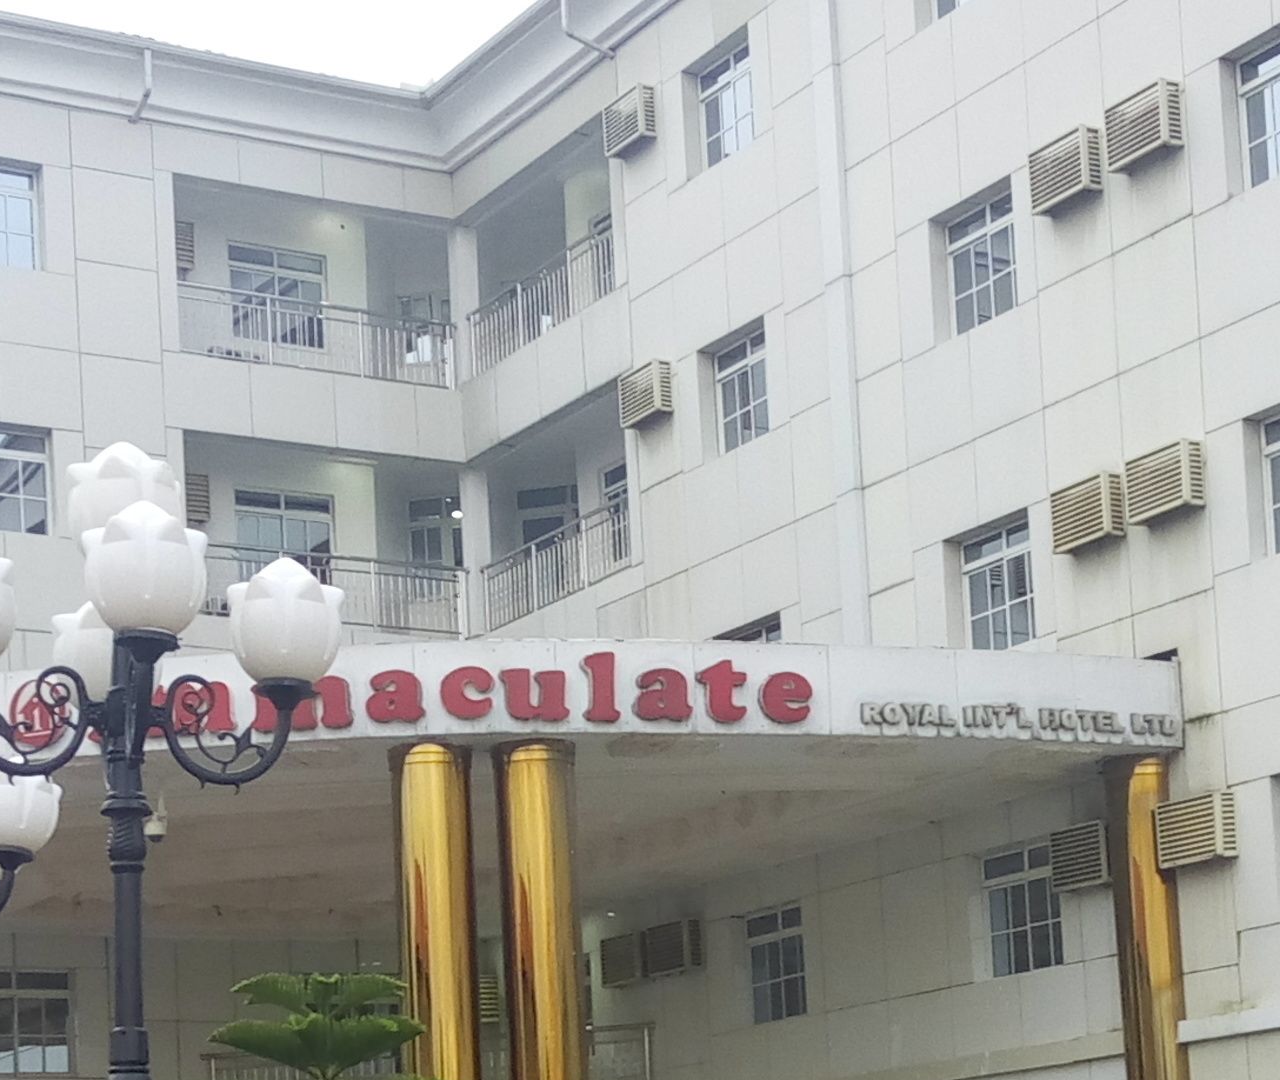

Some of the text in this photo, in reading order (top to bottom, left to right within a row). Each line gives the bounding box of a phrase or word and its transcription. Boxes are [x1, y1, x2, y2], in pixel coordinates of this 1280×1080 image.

[87, 651, 813, 743] mmaculate
[860, 702, 1177, 737] ROYAL INT'L HOTEL LTD
